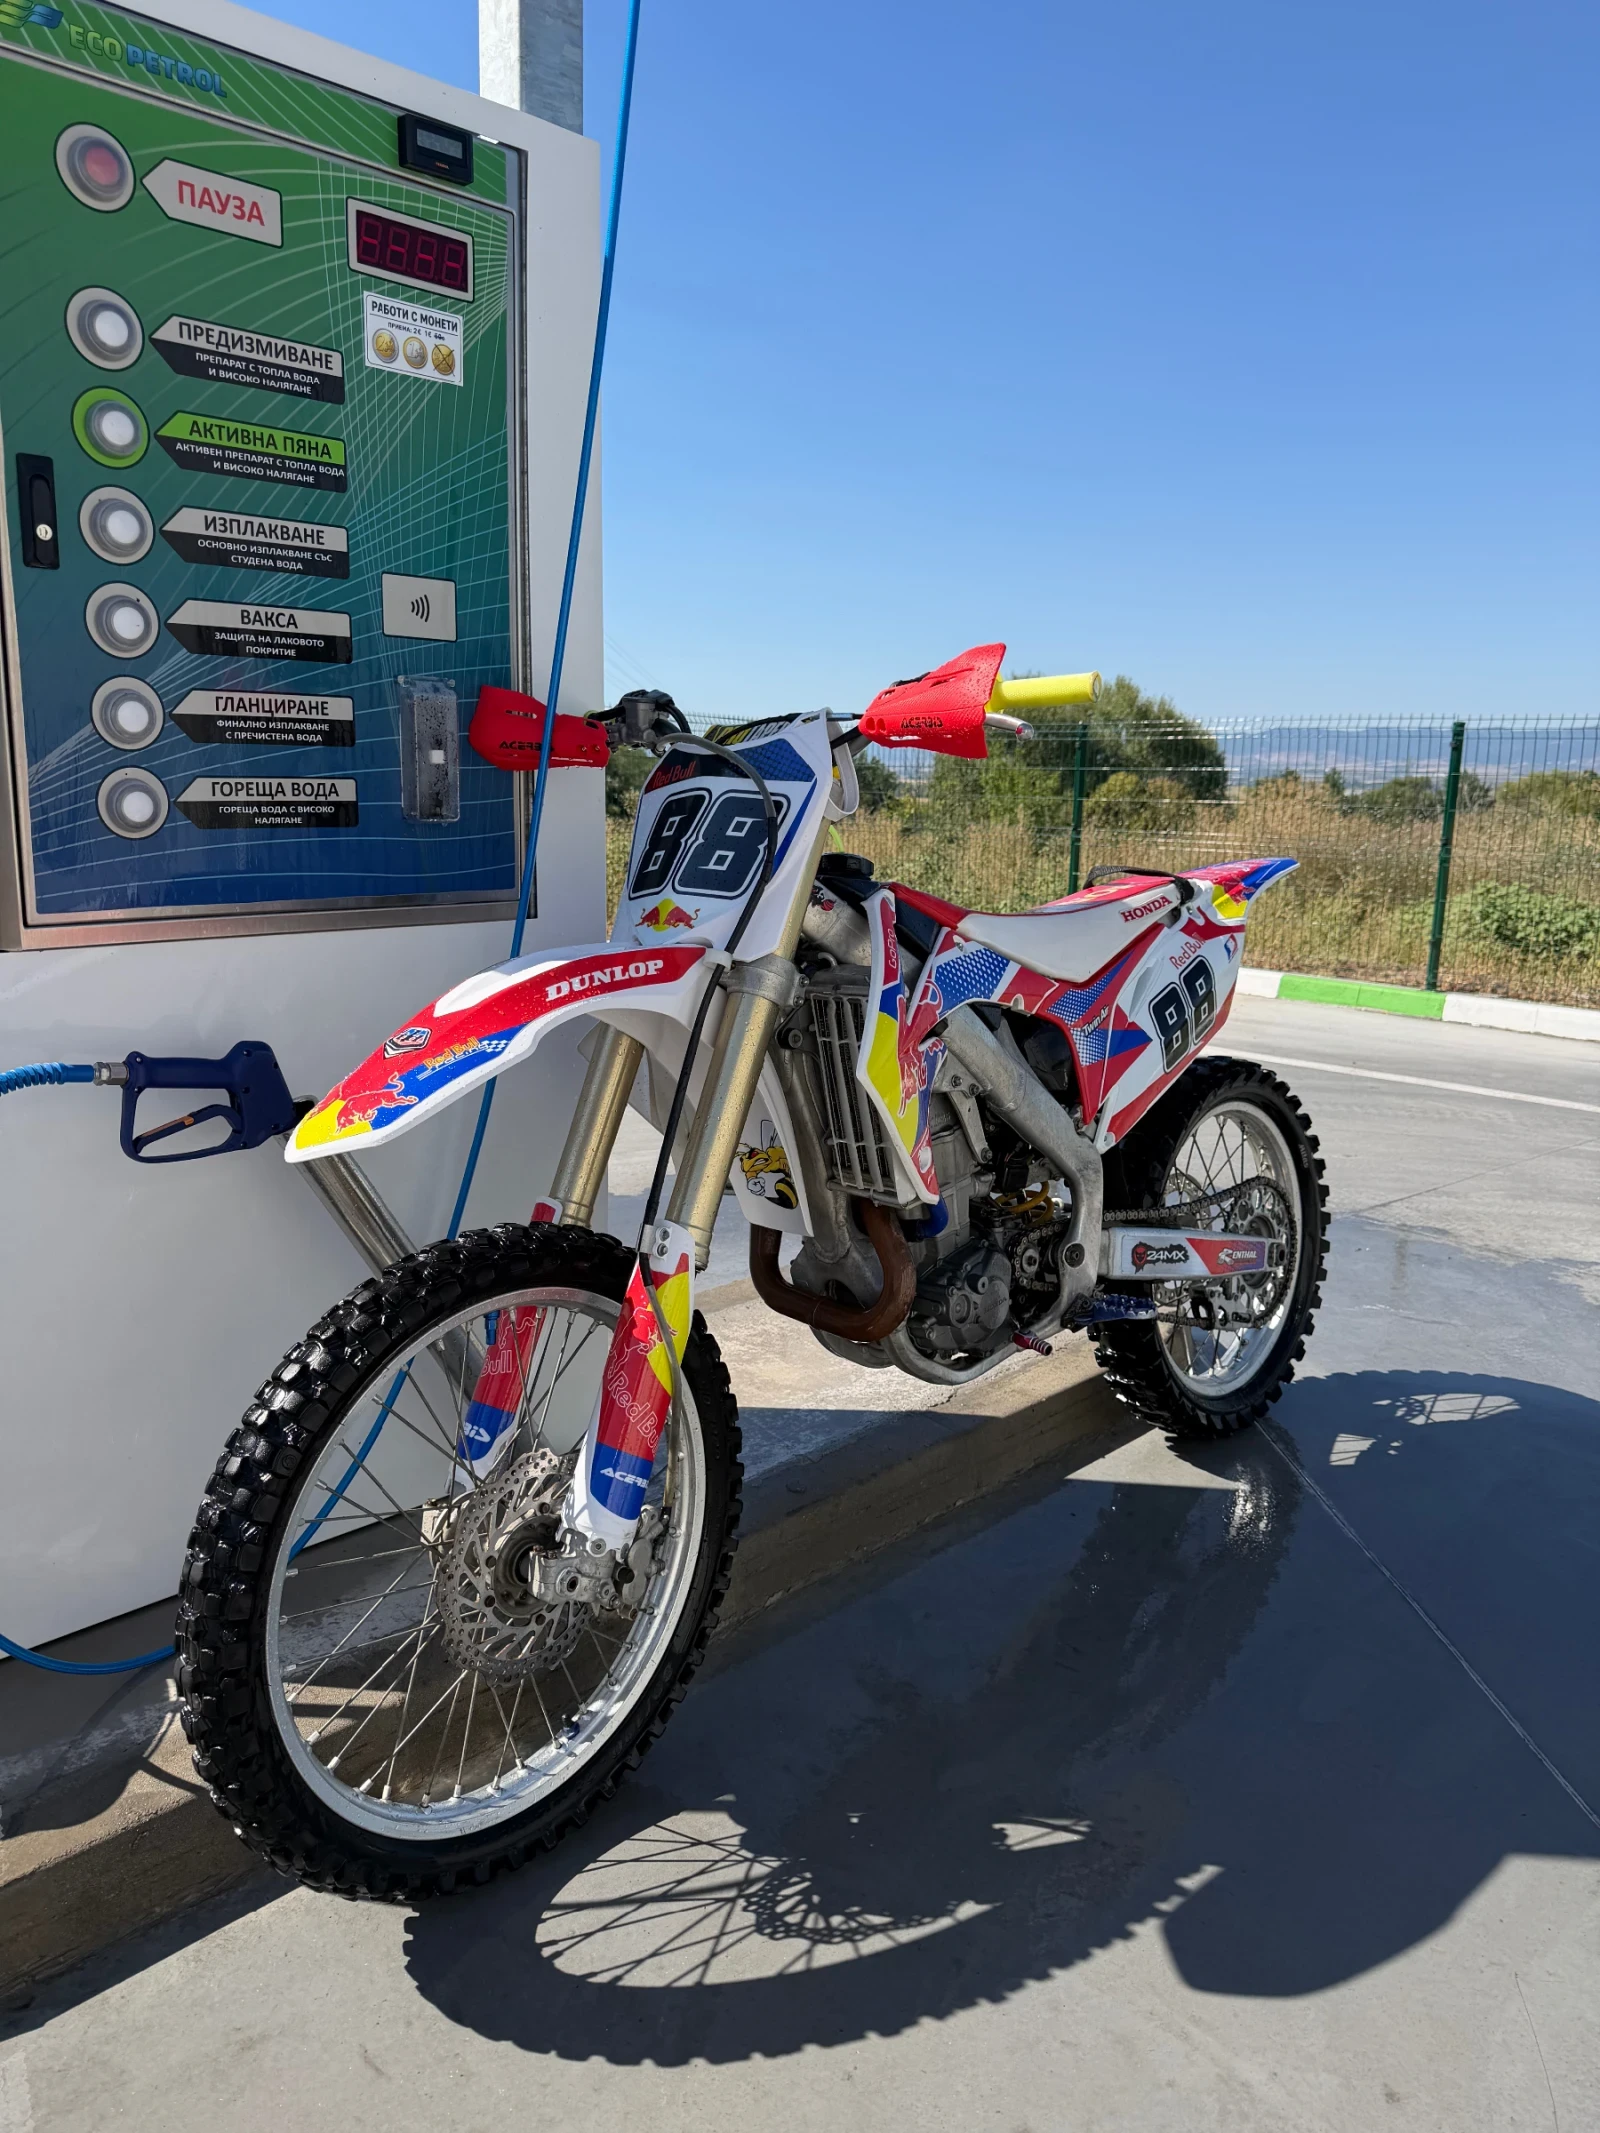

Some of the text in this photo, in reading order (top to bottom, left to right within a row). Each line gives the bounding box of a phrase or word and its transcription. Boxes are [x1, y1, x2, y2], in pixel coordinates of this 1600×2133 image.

[68, 24, 228, 98] ECOPETROL
[178, 180, 265, 226] ПАУЗА
[371, 300, 458, 332] РАБОТИ С МОНЕТИ
[179, 322, 334, 370] ПРЕДИЗМИВАНЕ
[196, 352, 320, 384] ПРЕПАРАТ С ТОПЛА ВОДА
[208, 367, 312, 394] И ВИСОКО НАЛЯГАНЕ
[189, 420, 332, 459] АКТИВНА ПЯНА
[176, 442, 344, 477] АКТИВЕН ПРЕПАРАТ С ТОПЛА ВОДА
[213, 460, 315, 484] И ВИСОКО НАЛЯГАНЕ
[204, 515, 326, 546] ИЗПЛАКВАНЕ
[198, 539, 332, 562] ОСНОВНО ИЗПЛАКВАНЕ СЪС
[231, 555, 303, 570] СТУДЕНА ВОДА
[240, 609, 298, 629] ВАКСА
[214, 632, 325, 648] ЗАЩИТА НА ЛАКОВОТО
[246, 646, 296, 657] ПОКРИТИЕ
[215, 696, 330, 717] ГЛАНЦИРАНЕ
[216, 720, 330, 731] ФИНАЛНО ИЗПЛАКВАНЕ
[234, 732, 294, 741] ПРЕЧИСТЕНА
[296, 734, 322, 742] ВОДА
[653, 760, 696, 788] Red Bull
[211, 781, 340, 800] ГОРЕЩА ВОДА
[219, 806, 259, 814] ГОРЕЩА
[261, 806, 288, 814] ВОДА
[254, 816, 302, 824] НАЛЯГАНЕ
[629, 787, 791, 900] 88
[1121, 895, 1172, 923] HONDA
[1169, 932, 1206, 970] Red Bull
[546, 960, 663, 1002] DUNLOP
[1082, 1004, 1109, 1037] Twin Air
[1148, 954, 1218, 1074] 88
[423, 1036, 480, 1070] Red Bull
[1147, 1250, 1186, 1260] 24MX
[608, 1370, 650, 1422] Red
